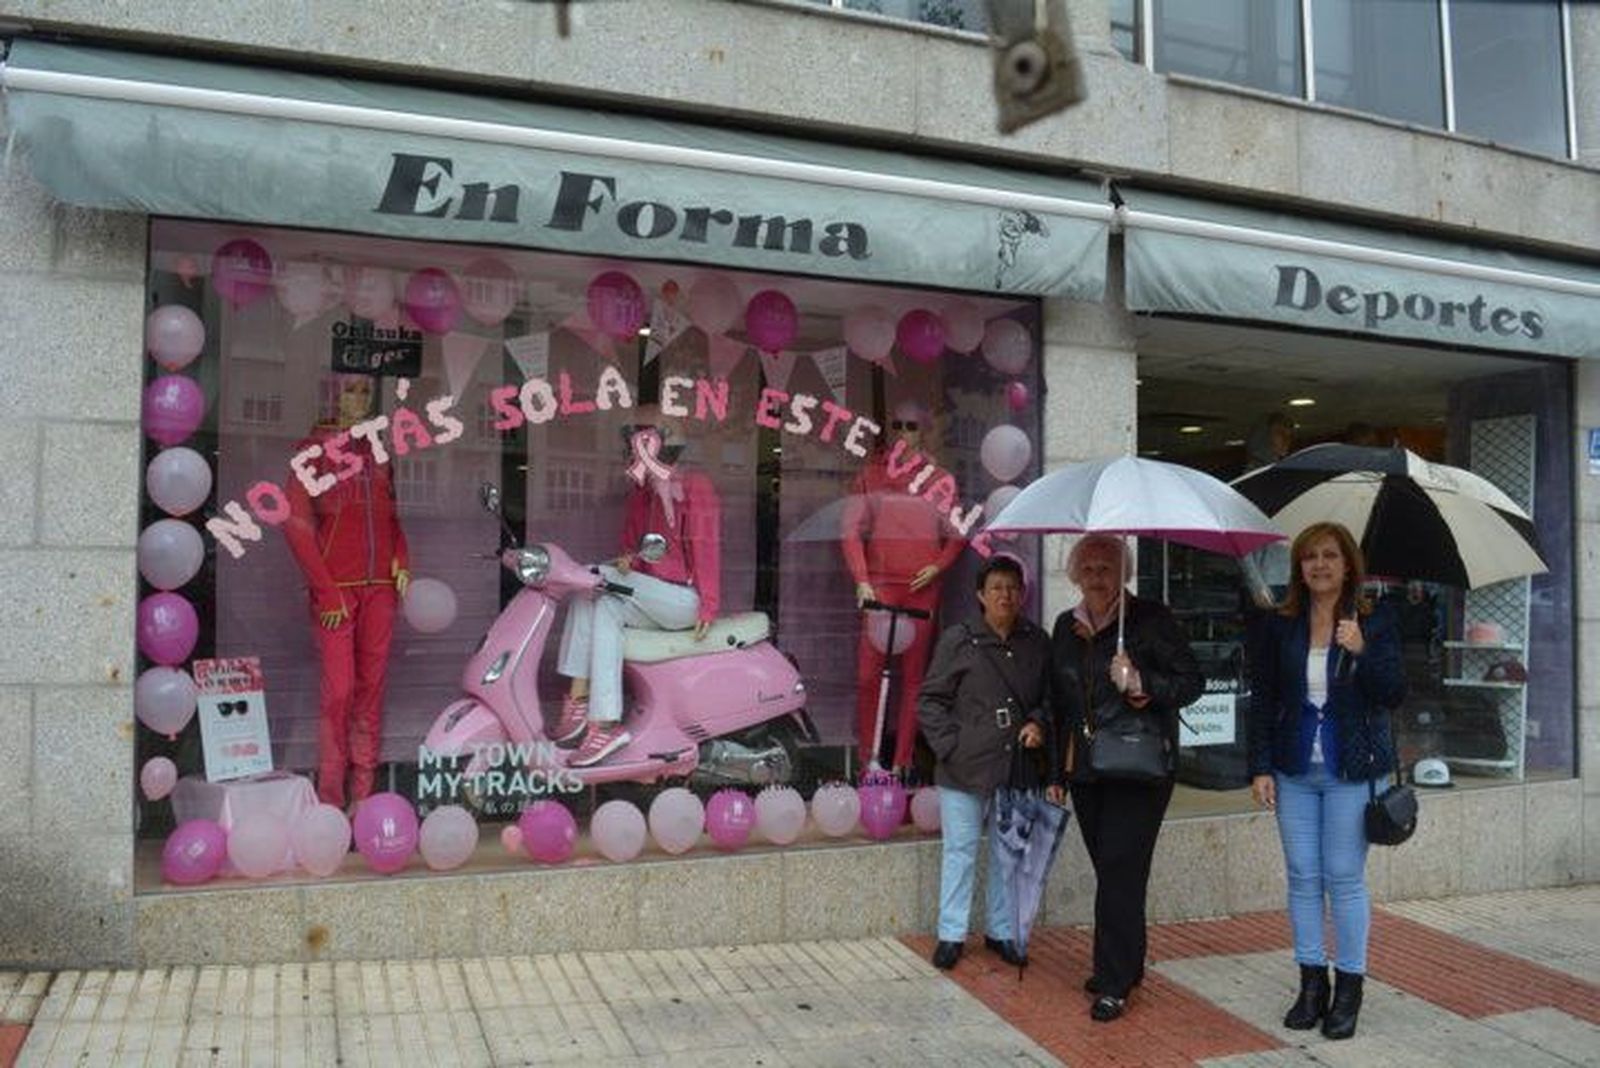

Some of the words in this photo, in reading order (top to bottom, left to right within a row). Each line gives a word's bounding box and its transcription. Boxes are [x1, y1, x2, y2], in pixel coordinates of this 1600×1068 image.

[373, 153, 519, 223] En
[543, 171, 872, 260] Forma
[1274, 265, 1544, 340] Deportes
[206, 481, 291, 559] NO
[491, 365, 632, 430] SOLA
[661, 376, 730, 423] EN
[755, 387, 881, 458] ESTE
[418, 744, 462, 770] MY
[469, 742, 556, 768] TOWN
[418, 771, 462, 799] MY
[470, 769, 584, 797] TRACKS
